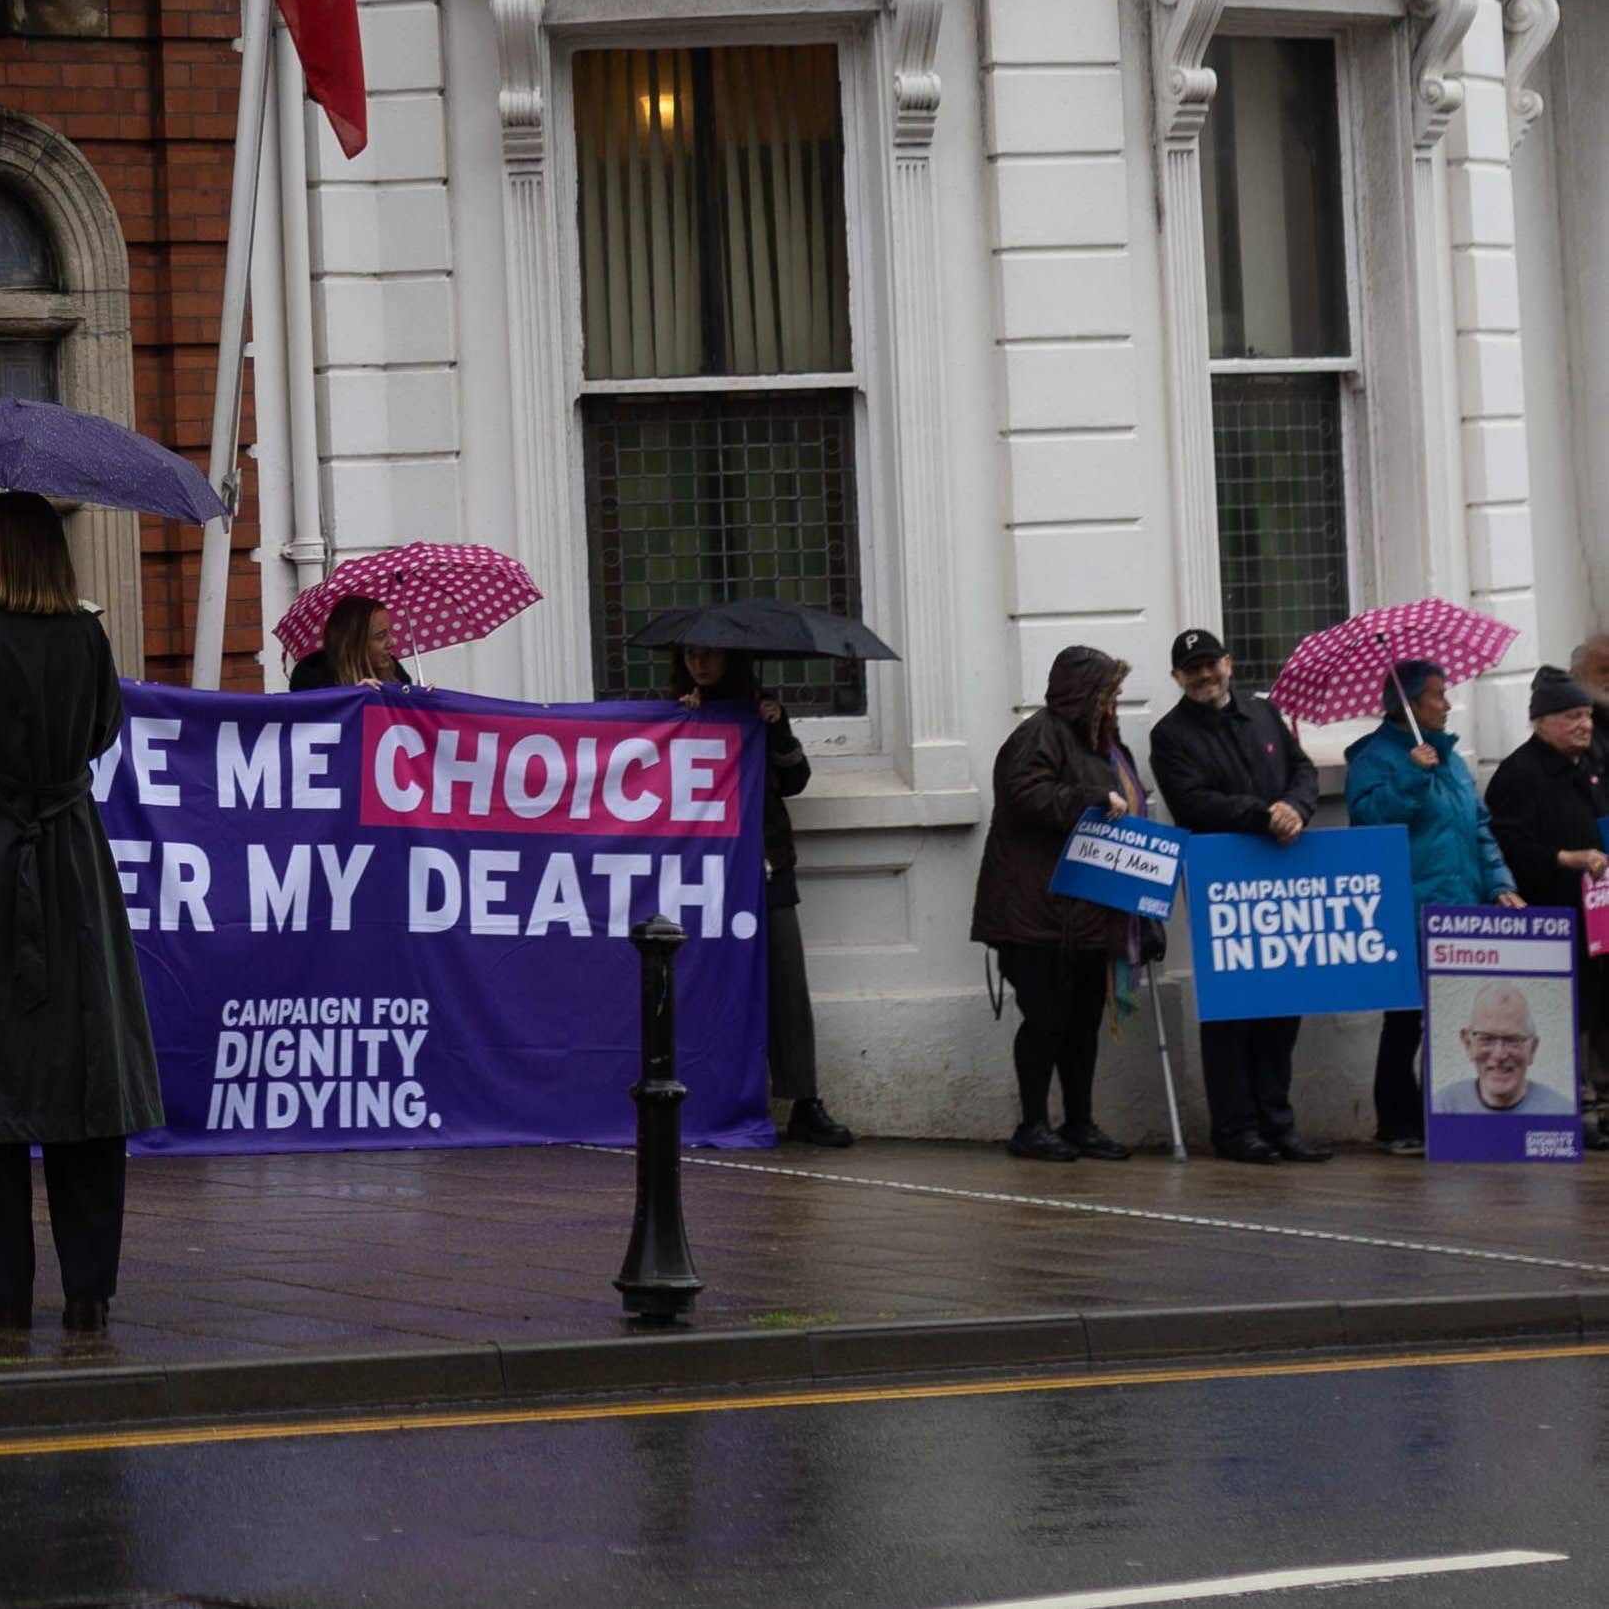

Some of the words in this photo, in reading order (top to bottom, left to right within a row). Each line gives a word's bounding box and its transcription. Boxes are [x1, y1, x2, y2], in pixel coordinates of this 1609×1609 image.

[1186, 633, 1199, 650] P
[88, 716, 181, 807] VE
[216, 721, 342, 810] ME
[373, 724, 726, 823] CHOICE
[1078, 821, 1148, 847] CAMPAIGN
[1149, 837, 1181, 857] FOR
[1078, 841, 1100, 859] Isle
[1105, 848, 1121, 871] of
[1126, 854, 1159, 874] Man
[108, 839, 215, 932] ER
[247, 843, 375, 933] MY
[408, 847, 757, 938] DEATH.
[1208, 876, 1327, 902] CAMPAIGN
[1334, 874, 1381, 896] FOR
[1209, 895, 1382, 937] DIGNITY
[1428, 915, 1527, 935] CAMPAIGN
[1531, 917, 1571, 936] FOR
[1211, 937, 1255, 972] IN
[1260, 929, 1398, 969] DYING.
[1434, 944, 1499, 964] Simon
[221, 997, 361, 1027] CAMPAIGN
[373, 998, 430, 1025] FOR
[214, 1028, 429, 1079] DIGNITY
[206, 1082, 257, 1130] IN
[266, 1081, 442, 1129] DYING.
